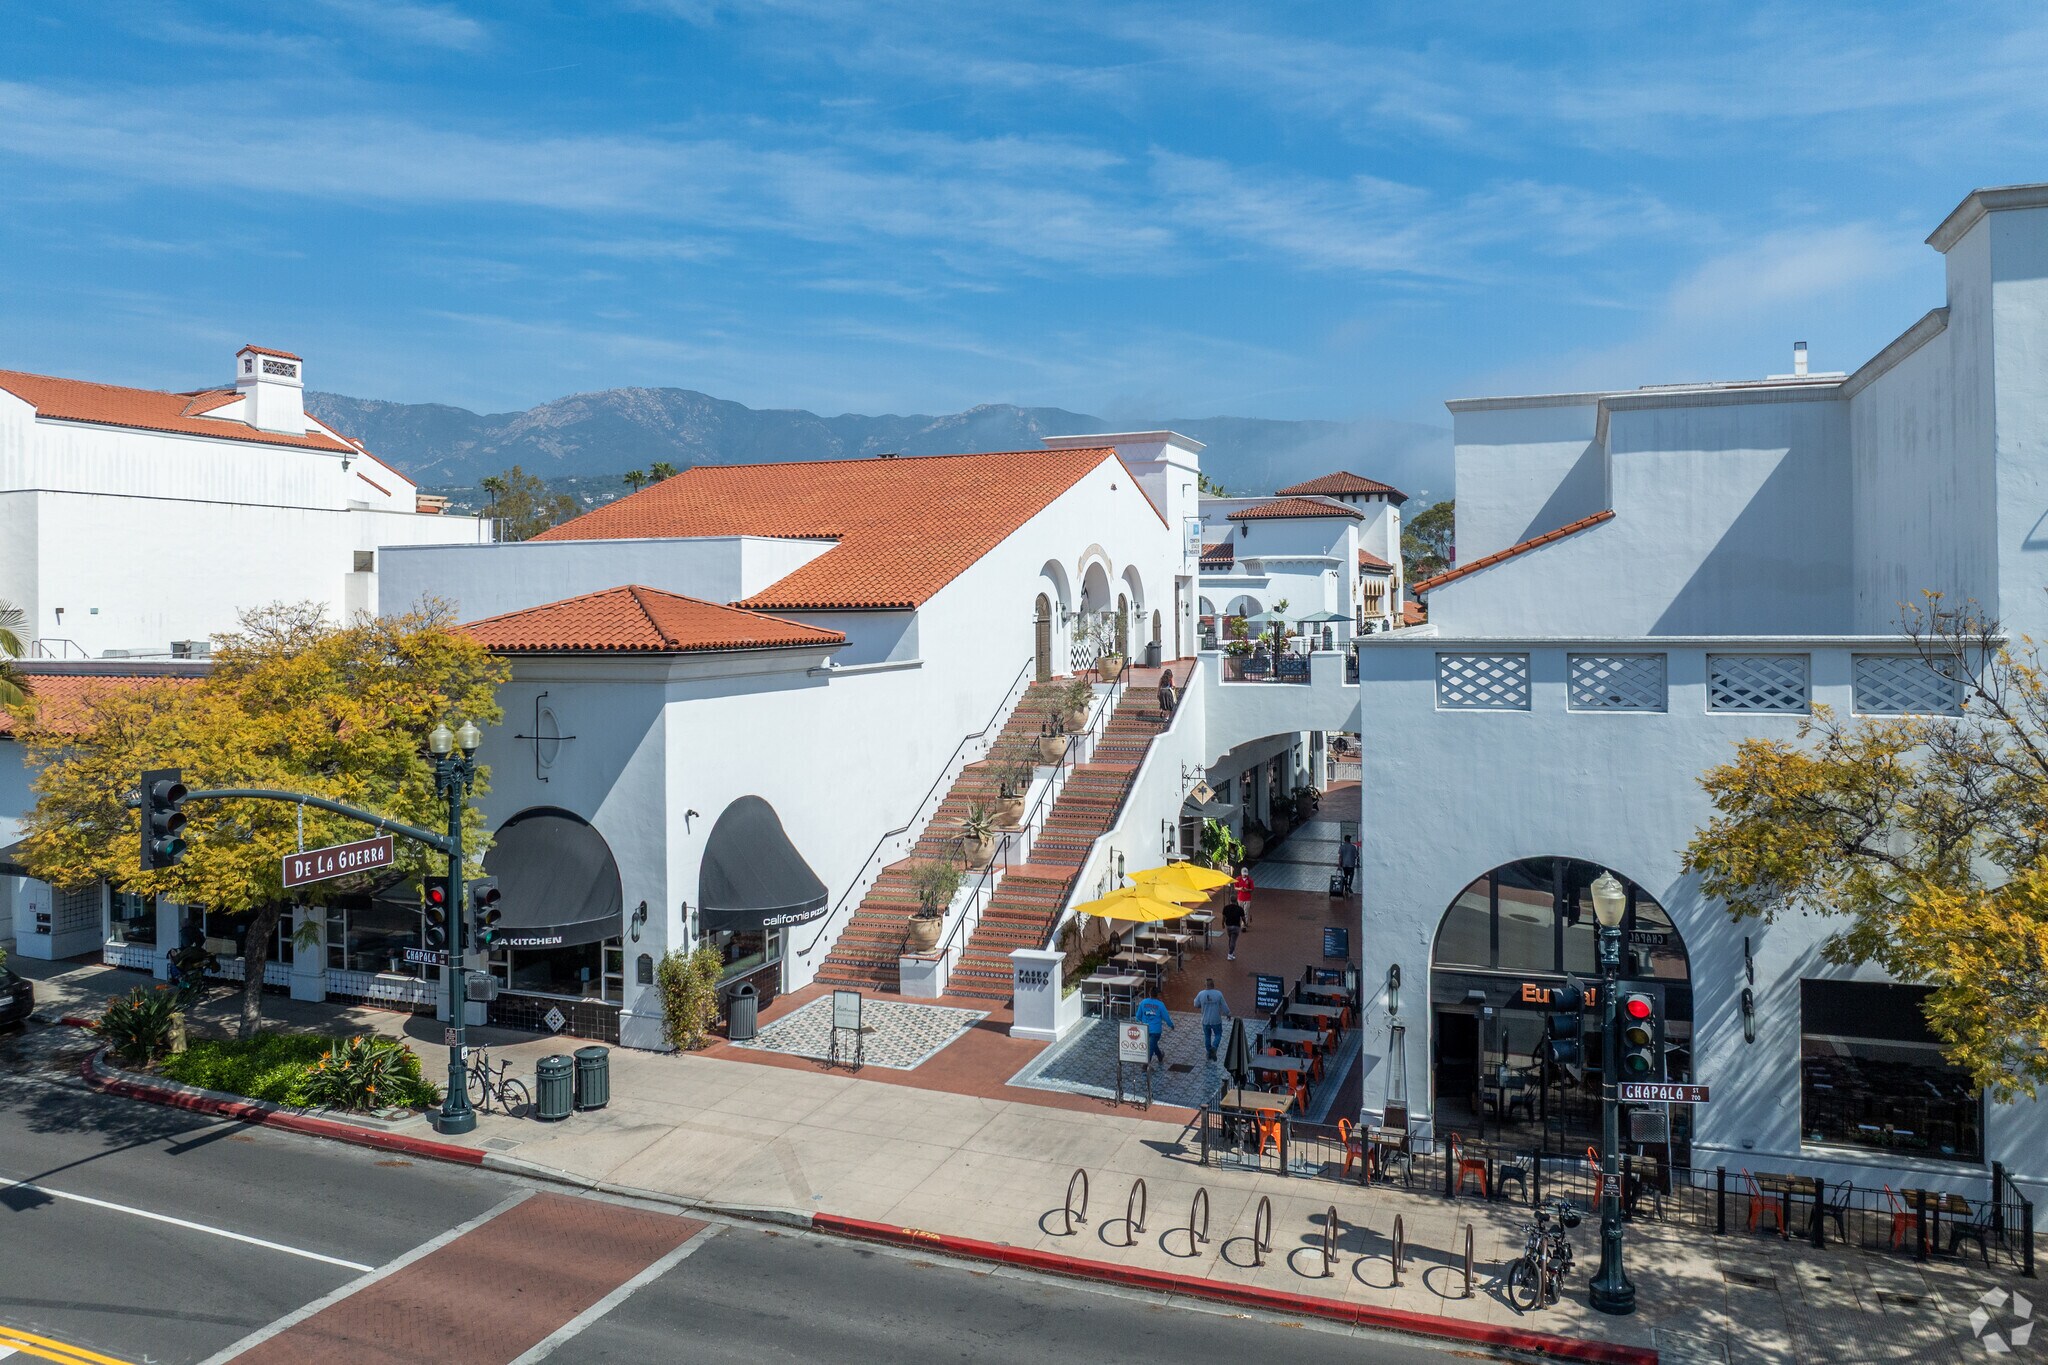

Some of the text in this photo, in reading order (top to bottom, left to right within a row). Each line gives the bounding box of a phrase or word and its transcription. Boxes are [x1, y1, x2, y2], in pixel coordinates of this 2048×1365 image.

[295, 846, 384, 879] DE LA GUERRA
[763, 911, 810, 926] california
[510, 936, 562, 946] KITCHEN
[406, 949, 437, 964] CHAPALA
[1019, 969, 1049, 979] PASEO
[1019, 976, 1049, 986] NUEVO
[1626, 1085, 1684, 1100] CHAPALA
